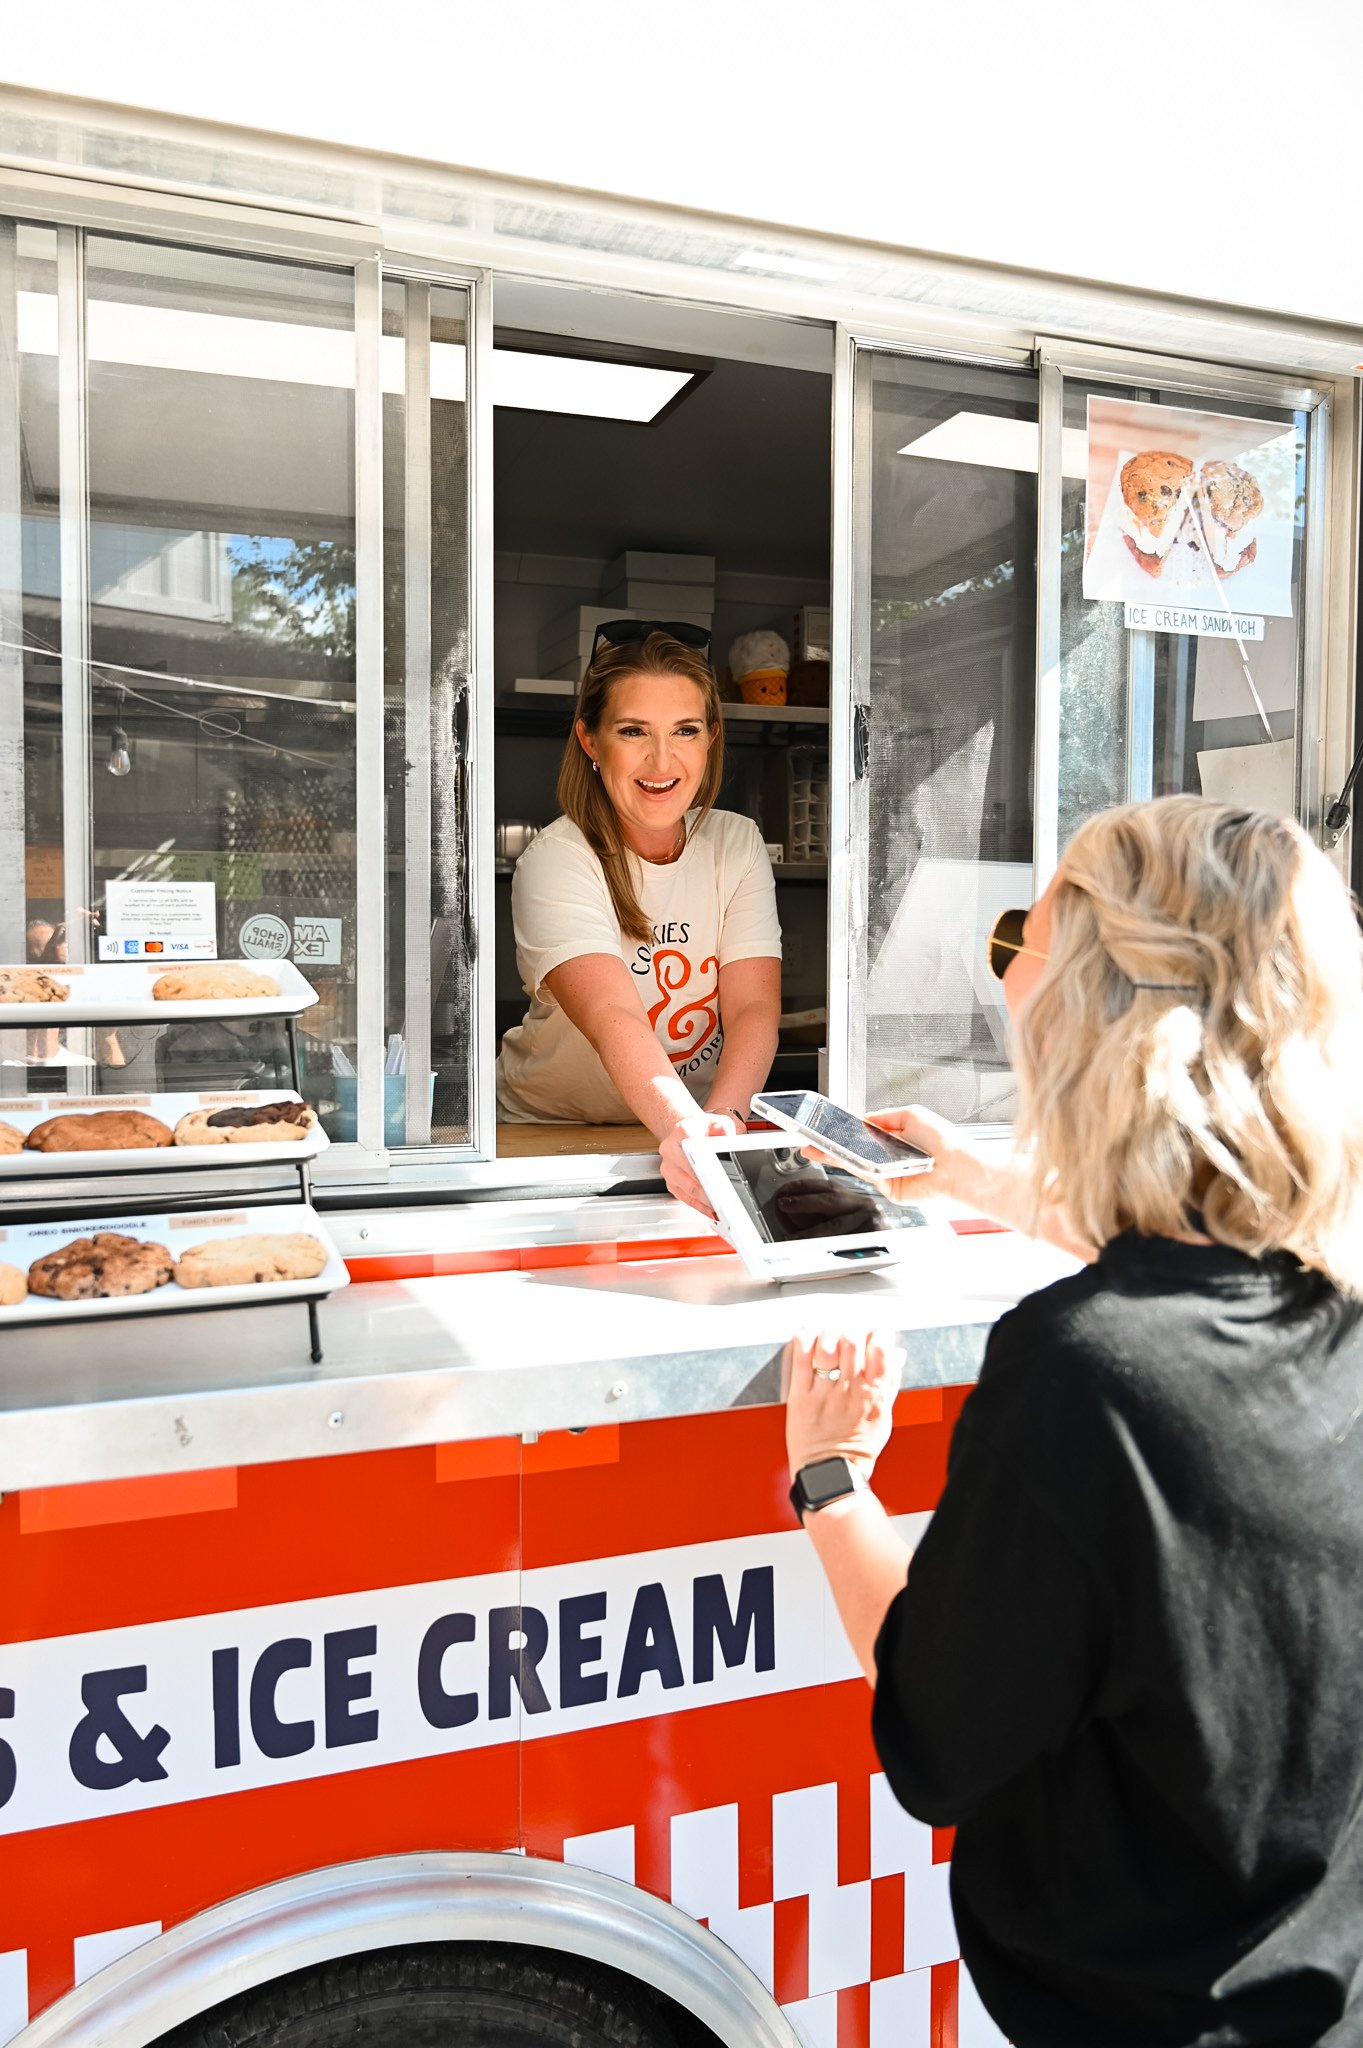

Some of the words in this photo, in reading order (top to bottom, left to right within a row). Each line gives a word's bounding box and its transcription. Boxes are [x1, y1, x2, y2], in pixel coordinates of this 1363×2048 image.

[1128, 608, 1148, 625] ICE
[1155, 609, 1198, 631] CREAM
[631, 922, 691, 976] COKIES
[59, 1099, 138, 1107] SNICKERDOODLE
[61, 1221, 148, 1234] SNICKERDOODLE
[68, 1664, 170, 1790] &
[212, 1624, 380, 1770] ICE
[417, 1565, 776, 1730] CREAM
